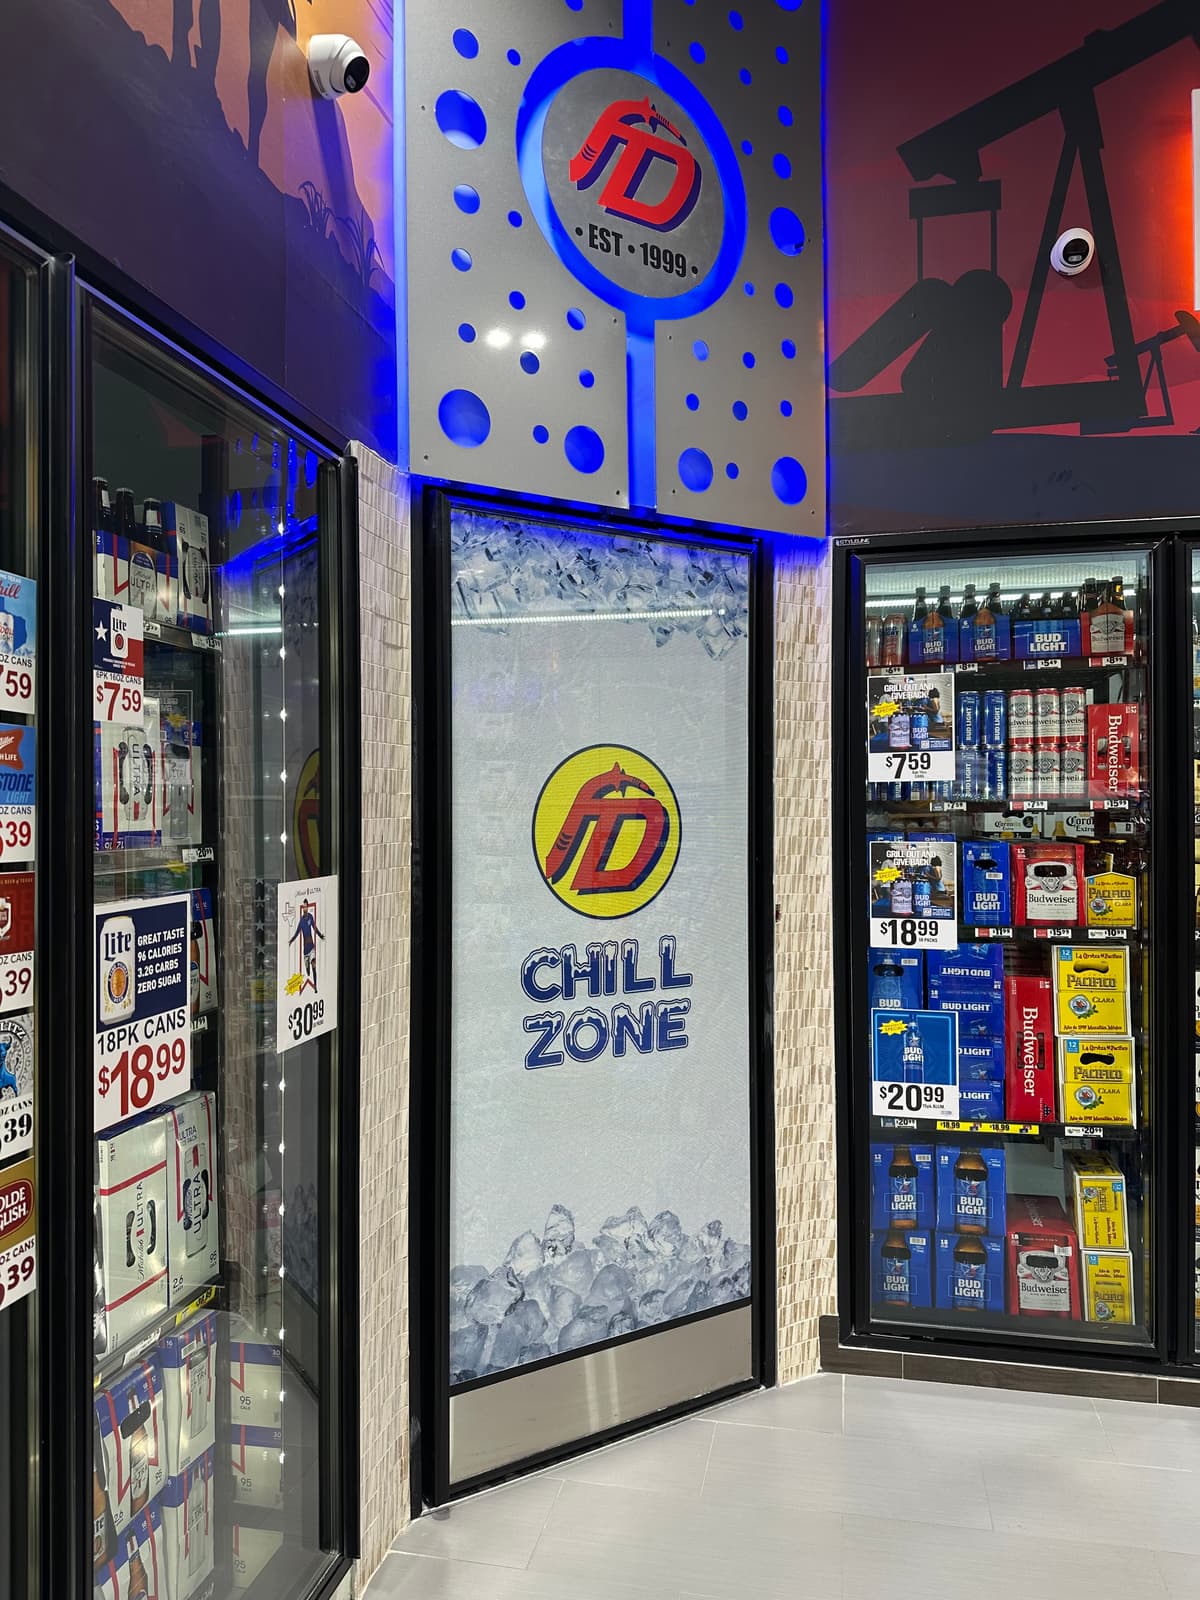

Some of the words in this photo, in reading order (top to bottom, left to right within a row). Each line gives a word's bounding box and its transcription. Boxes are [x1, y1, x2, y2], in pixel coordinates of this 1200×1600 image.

[589, 223, 622, 257] EST
[640, 242, 687, 278] 1999
[131, 578, 155, 592] ULTRA
[112, 617, 127, 632] Lite
[1034, 633, 1062, 643] BUD
[1029, 642, 1067, 652] LIGHT
[11, 656, 33, 668] CANS
[0, 665, 32, 699] 59
[125, 674, 142, 685] CANS
[884, 684, 903, 693] GRILL
[96, 681, 142, 720] $759
[5, 753, 17, 761] LIFE
[1107, 714, 1122, 792] Budweiser
[132, 743, 141, 796] ULTRA
[885, 752, 931, 779] $759
[6, 791, 30, 805] LIGHT
[10, 806, 32, 815] CANS
[0, 820, 31, 852] 39
[886, 850, 905, 858] GRILL
[906, 850, 921, 858] OUT
[893, 858, 909, 866] GIVE
[975, 893, 998, 902] BUD
[1028, 893, 1075, 904] Budweiser
[973, 902, 1001, 910] LIGHT
[137, 934, 161, 947] GREAT
[162, 927, 185, 942] TASTE
[880, 919, 939, 946] $1899
[104, 931, 132, 961] Lite
[137, 952, 147, 962] 96
[148, 943, 182, 960] CALORIES
[10, 952, 33, 963] CANS
[137, 966, 154, 978] 3.2G
[155, 958, 179, 973] CARBS
[520, 934, 694, 1004] CHILL
[942, 967, 969, 976] LIGHT
[970, 968, 991, 977] BUD
[0, 968, 32, 1003] 39
[137, 980, 157, 994] ZERO
[157, 973, 182, 989] SUGAR
[879, 999, 901, 1008] BUD
[942, 1002, 962, 1010] BUD
[963, 1003, 990, 1011] LIGHT
[288, 999, 325, 1041] $3099
[98, 1023, 139, 1055] 18PK
[144, 1009, 186, 1039] CANS
[522, 998, 692, 1070] ZONE
[963, 1048, 992, 1056] LIGHT
[1023, 1006, 1038, 1097] Budweiser
[98, 1038, 186, 1117] $1899
[879, 1083, 944, 1111] $2099
[963, 1092, 990, 1100] LIGHT
[11, 1098, 32, 1113] CANS
[0, 1113, 32, 1145] 39
[136, 1182, 144, 1227] ULTRA
[193, 1172, 202, 1234] ULTRA
[893, 1194, 914, 1202] BUD
[960, 1196, 984, 1206] BUD
[891, 1202, 917, 1210] LIGHT
[957, 1205, 986, 1215] LIGHT
[13, 1238, 35, 1257] CANS
[0, 1255, 34, 1300] 39
[886, 1275, 906, 1284] BUD
[958, 1279, 981, 1288] BUD
[883, 1283, 909, 1291] LIGHT
[955, 1287, 984, 1298] LIGHT
[1021, 1283, 1067, 1294] Budweiser
[239, 1395, 251, 1406] 95
[241, 1477, 252, 1487] 95
